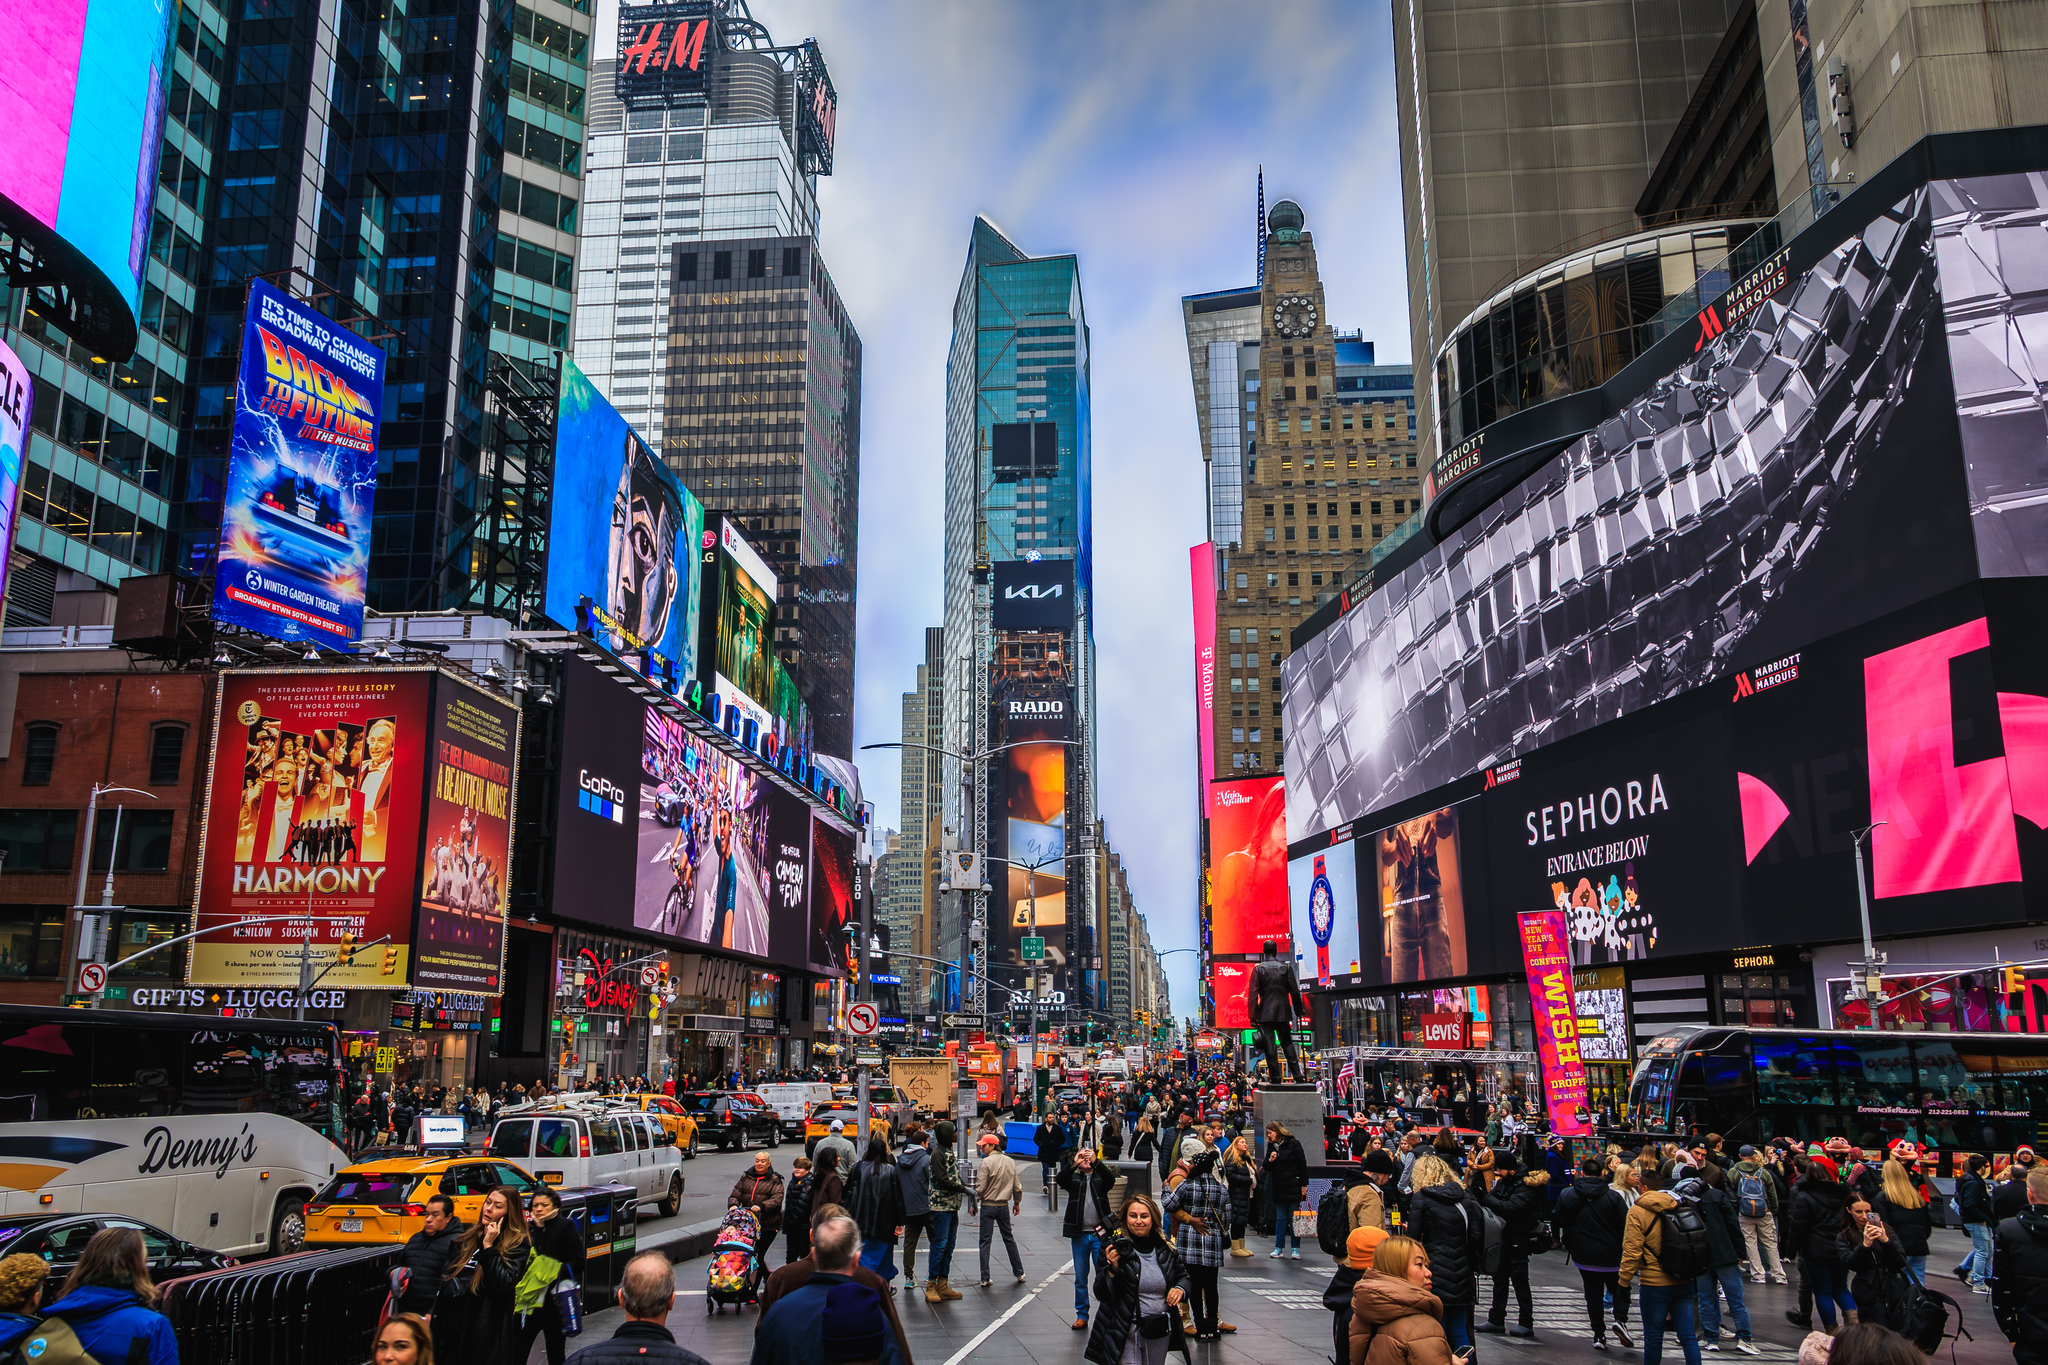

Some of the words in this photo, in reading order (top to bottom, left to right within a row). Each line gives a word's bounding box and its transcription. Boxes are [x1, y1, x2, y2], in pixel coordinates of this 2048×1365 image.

[622, 19, 709, 75] H&M
[1726, 247, 1792, 306] MARRIOTT
[1727, 268, 1785, 323] MARQUIS
[261, 307, 326, 352] BROADWAY
[328, 345, 375, 380] HISTORY!
[262, 295, 285, 316] IT'S
[286, 309, 313, 331] TIME
[316, 325, 330, 342] TO
[332, 336, 377, 369] CHANGE
[257, 324, 368, 415] BACK
[266, 377, 291, 401] TO
[260, 396, 288, 416] THE
[288, 387, 373, 442] FUTURE
[315, 431, 335, 444] THE
[335, 436, 370, 451] MUSICAL
[1436, 432, 1485, 474] MARRIOTT
[1437, 451, 1480, 490] MARQUIS
[1350, 569, 1376, 594] MARRIOTT
[1351, 583, 1373, 605] MARQUIS
[263, 578, 288, 597] WINTER
[289, 588, 314, 607] GARDEN
[315, 596, 340, 615] THEATRE
[234, 590, 270, 610] BROADWAY
[272, 602, 291, 616] BTWN
[291, 610, 308, 622] 50TH
[308, 616, 322, 627] AND
[322, 620, 335, 632] 51ST
[600, 610, 616, 628] break
[616, 624, 627, 639] you
[626, 628, 636, 646] into
[1754, 653, 1801, 678] MARRIOTT
[273, 686, 334, 694] EXTRAORDINARY
[336, 685, 361, 693] TRUE
[364, 684, 396, 692] STORY
[1202, 662, 1214, 710] Mobile
[1756, 667, 1798, 691] MARQUIS
[1009, 701, 1063, 713] RADO
[440, 739, 450, 764] THE
[449, 744, 463, 769] NEIL
[462, 749, 490, 779] DIAMOND
[489, 760, 510, 787] MUSICAL
[728, 704, 846, 811] BROADWAY
[1496, 758, 1522, 775] MARRIOTT
[579, 769, 625, 804] GoPro
[1496, 769, 1520, 785] MARQUIS
[436, 762, 444, 799] A
[443, 764, 485, 814] BEAUTIFUL
[484, 780, 509, 821] NOISE
[1527, 773, 1669, 846] SEPHORA
[1547, 843, 1605, 878] ENTRANCE
[1605, 835, 1650, 867] BELOW
[232, 865, 386, 895] HARMONY
[775, 860, 804, 885] CAMERA
[854, 867, 862, 900] 1500
[784, 883, 802, 908] FUN
[1525, 926, 1542, 935] NEW
[1526, 934, 1554, 944] YEAR'S
[250, 950, 274, 958] NOW
[1527, 944, 1543, 953] EVE
[1734, 954, 1775, 968] SEPHORA
[261, 960, 277, 968] week
[420, 955, 432, 963] FOUR
[431, 956, 449, 965] MATINEE
[449, 958, 480, 969] PERFORMANCES
[479, 962, 487, 970] PER
[1529, 956, 1569, 967] CONFETTI
[421, 970, 448, 979] BROADHURST
[447, 973, 463, 981] THEATRE
[695, 955, 748, 1001] FOREVER
[132, 988, 205, 1007] GIFTS
[224, 989, 346, 1009] LUGGAGE
[405, 990, 436, 1009] GIFTS
[442, 993, 486, 1012] LUGGAGE
[217, 1007, 223, 1017] I
[235, 1008, 257, 1018] NY
[444, 1009, 456, 1020] NY
[755, 1018, 765, 1028] POLO
[1542, 970, 1581, 1066] WISH
[452, 1021, 469, 1030] SONY
[706, 1032, 730, 1047] FOREVER
[376, 1048, 387, 1070] ATM
[1563, 1092, 1578, 1100] NEW
[138, 1121, 258, 1180] Denny's
